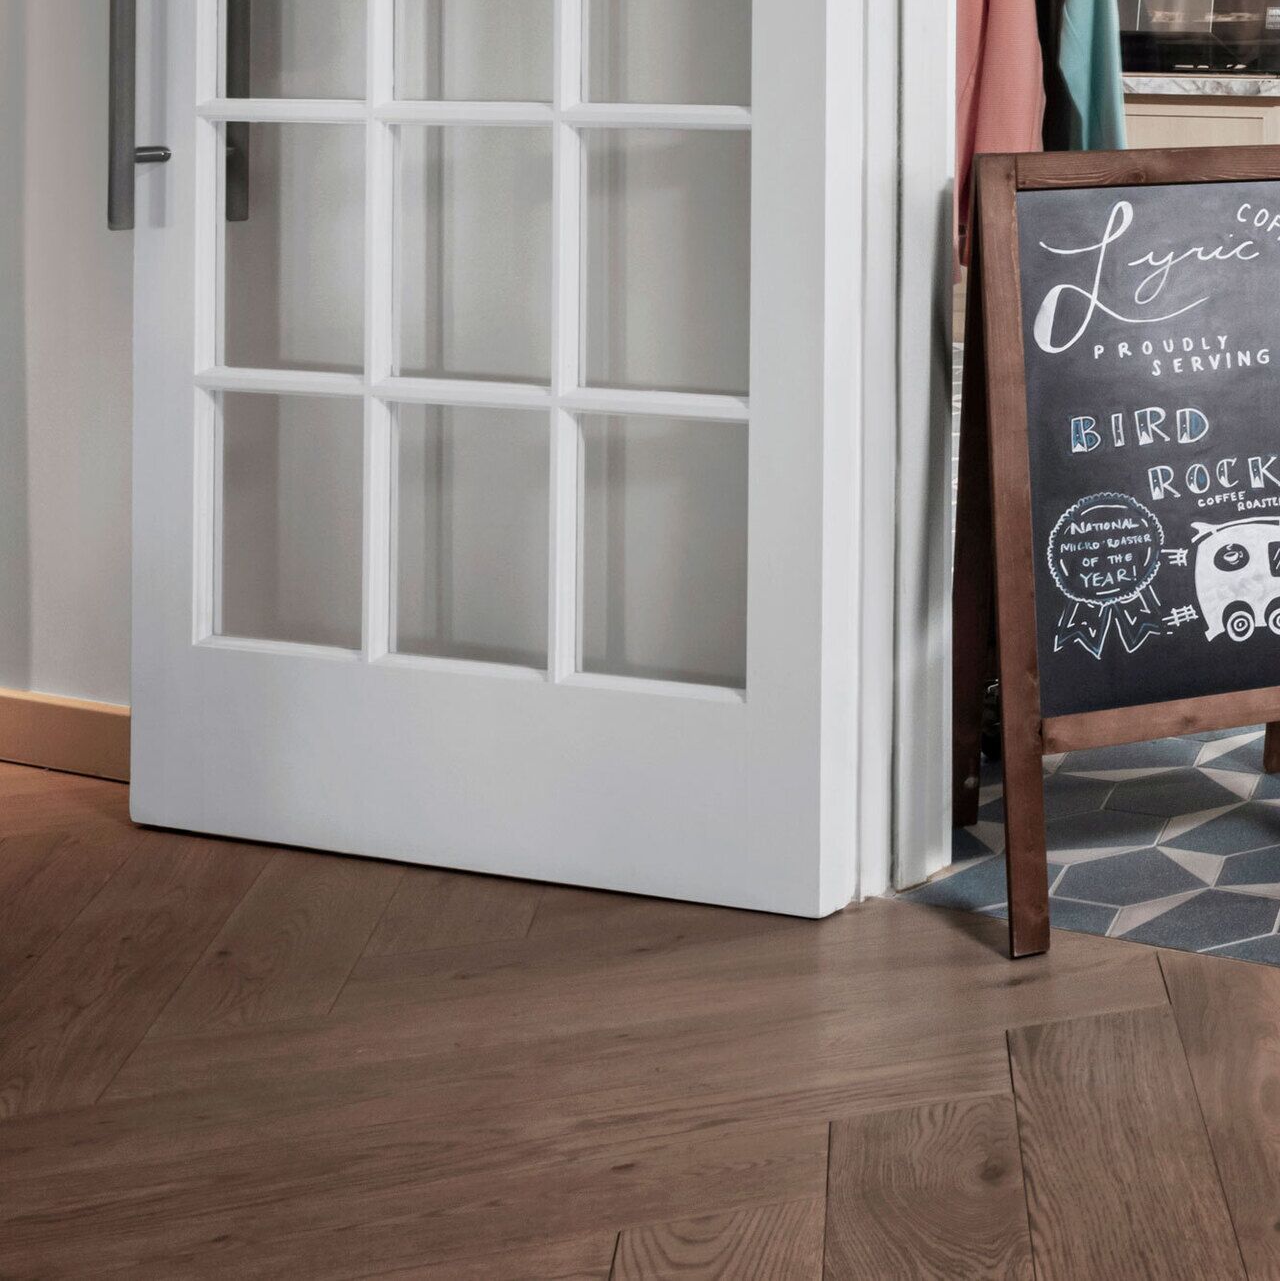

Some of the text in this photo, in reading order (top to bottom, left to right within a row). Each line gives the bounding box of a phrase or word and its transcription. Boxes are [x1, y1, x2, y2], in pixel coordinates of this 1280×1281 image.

[1034, 200, 1260, 354] Lyric
[1094, 335, 1228, 359] PROUDLY
[1152, 348, 1270, 376] SERVING
[1071, 406, 1209, 453] BIRD
[1197, 491, 1246, 508] COFFEE
[1070, 518, 1139, 535] NATIONAL
[1082, 553, 1133, 567] OF THE
[1080, 565, 1137, 588] YEAR!
